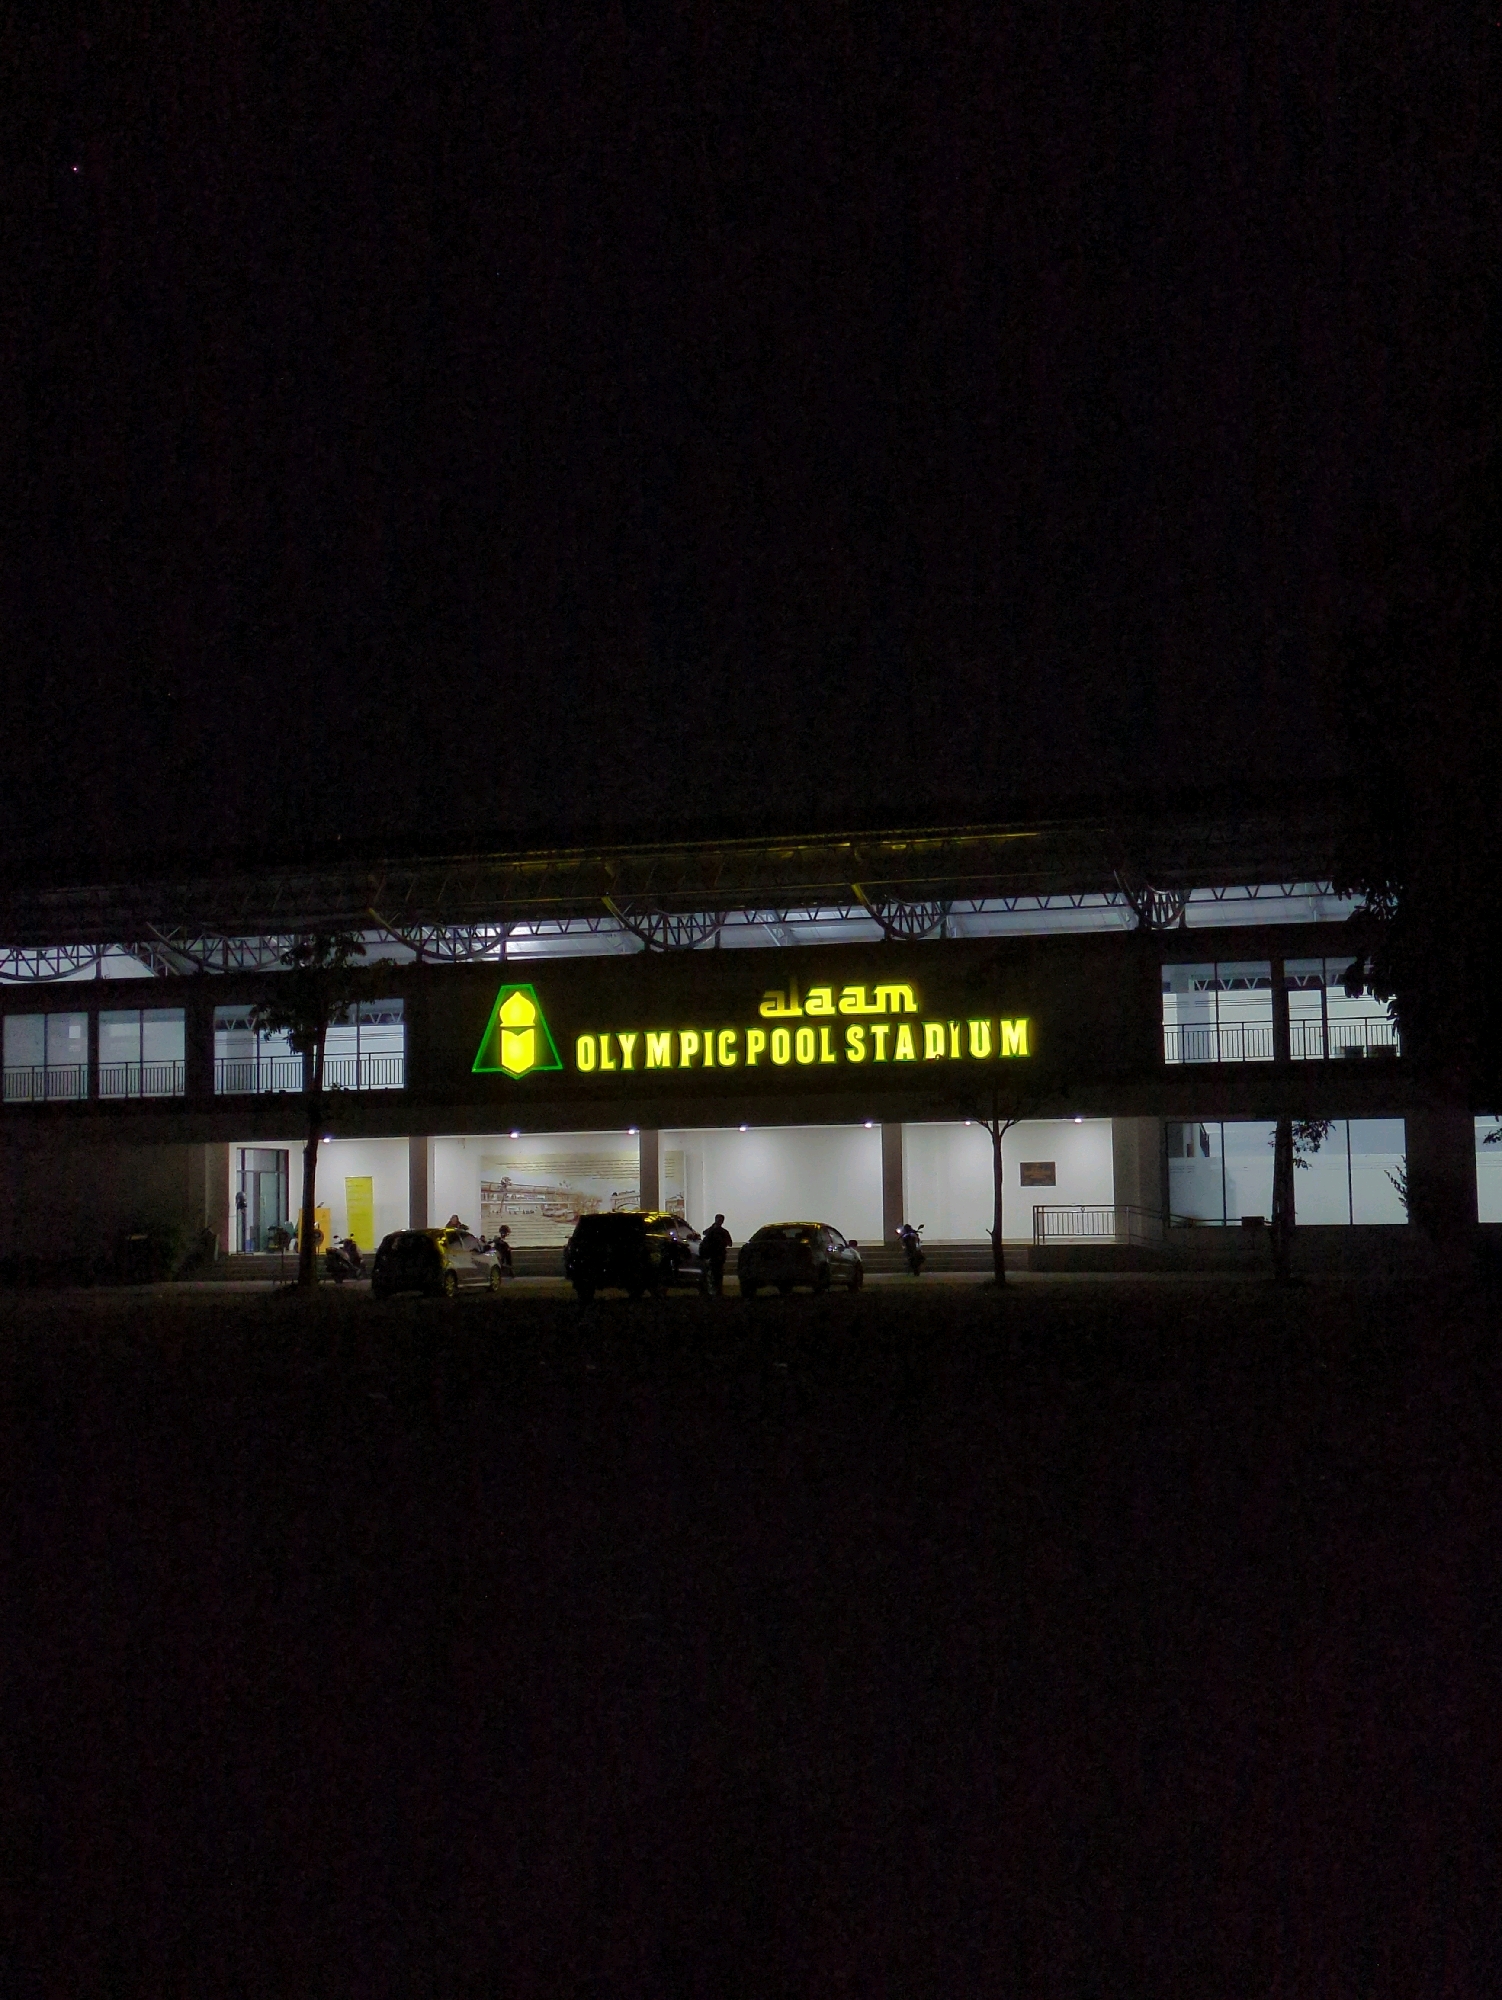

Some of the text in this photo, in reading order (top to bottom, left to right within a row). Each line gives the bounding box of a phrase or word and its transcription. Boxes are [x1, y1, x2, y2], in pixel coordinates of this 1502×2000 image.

[576, 1018, 1030, 1073] OLYMPIC POOL STADIUM
